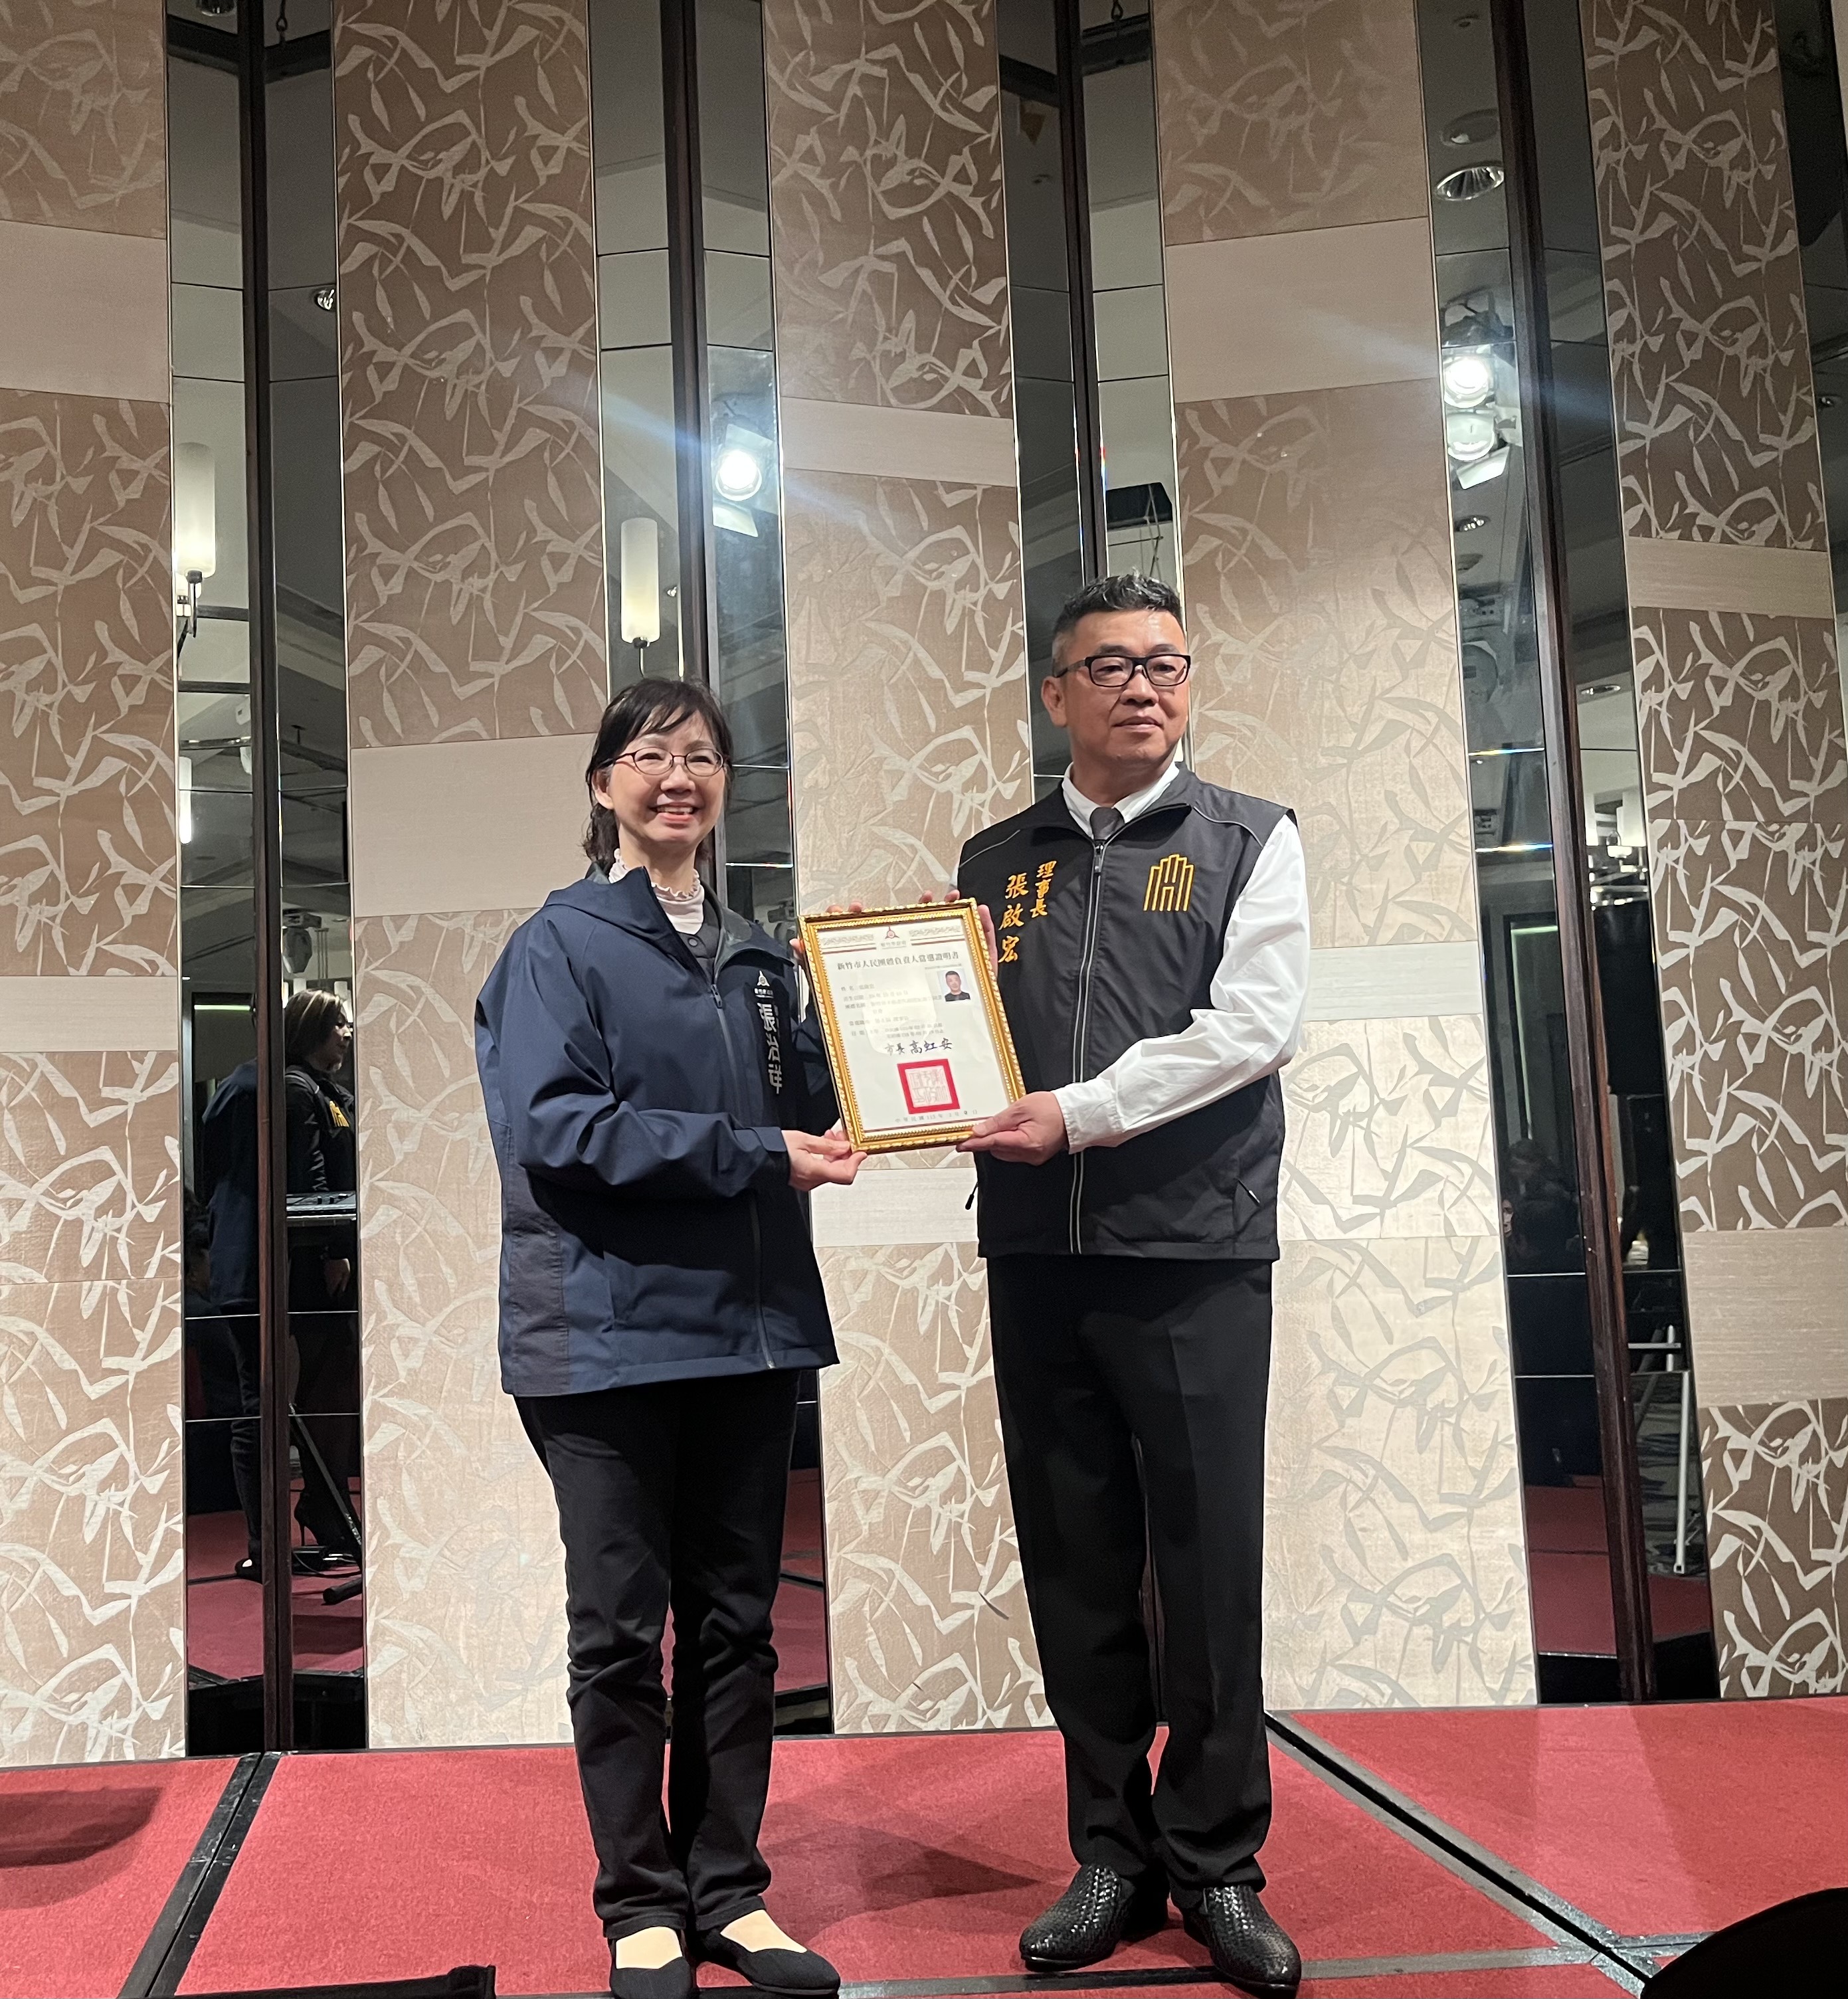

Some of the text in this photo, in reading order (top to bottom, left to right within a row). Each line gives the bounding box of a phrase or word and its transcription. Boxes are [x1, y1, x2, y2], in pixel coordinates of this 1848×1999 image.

[998, 872, 1029, 963] 張啟宏
[1030, 860, 1057, 918] 理事長
